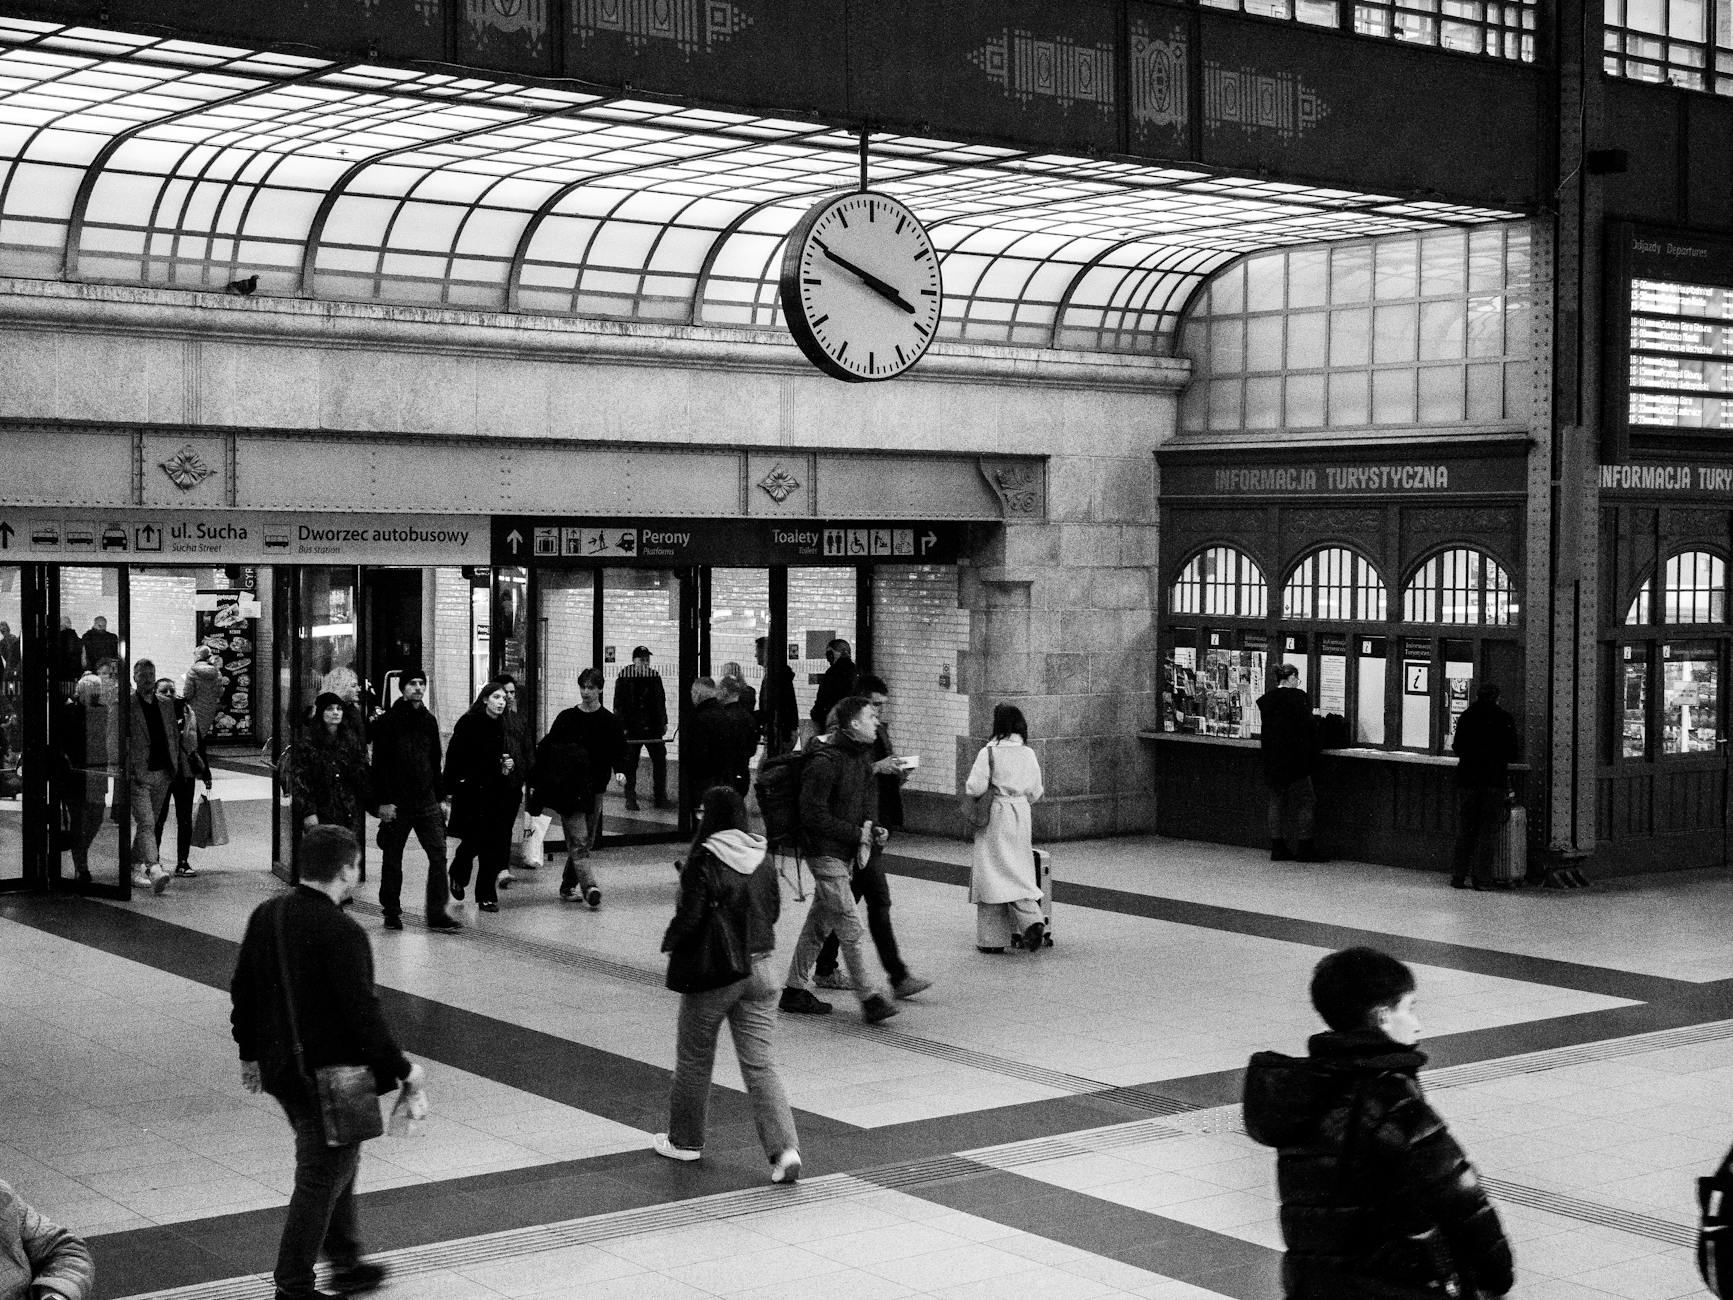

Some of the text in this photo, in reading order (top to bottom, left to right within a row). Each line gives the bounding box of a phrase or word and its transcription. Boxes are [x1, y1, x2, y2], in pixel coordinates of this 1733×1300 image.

[1666, 243, 1708, 257] Departures
[1215, 466, 1449, 490] INFORMACJA TURYSTYCZNA
[1598, 465, 1733, 490] INFORMACJA TURY
[171, 523, 248, 540] ul. Sucha
[298, 525, 468, 546] Dworzec autobusowy
[642, 529, 690, 547] Perony
[771, 529, 819, 547] Toalety
[171, 543, 222, 552] Sucha Street
[298, 545, 341, 554] Bus station
[642, 547, 675, 556] Platforms
